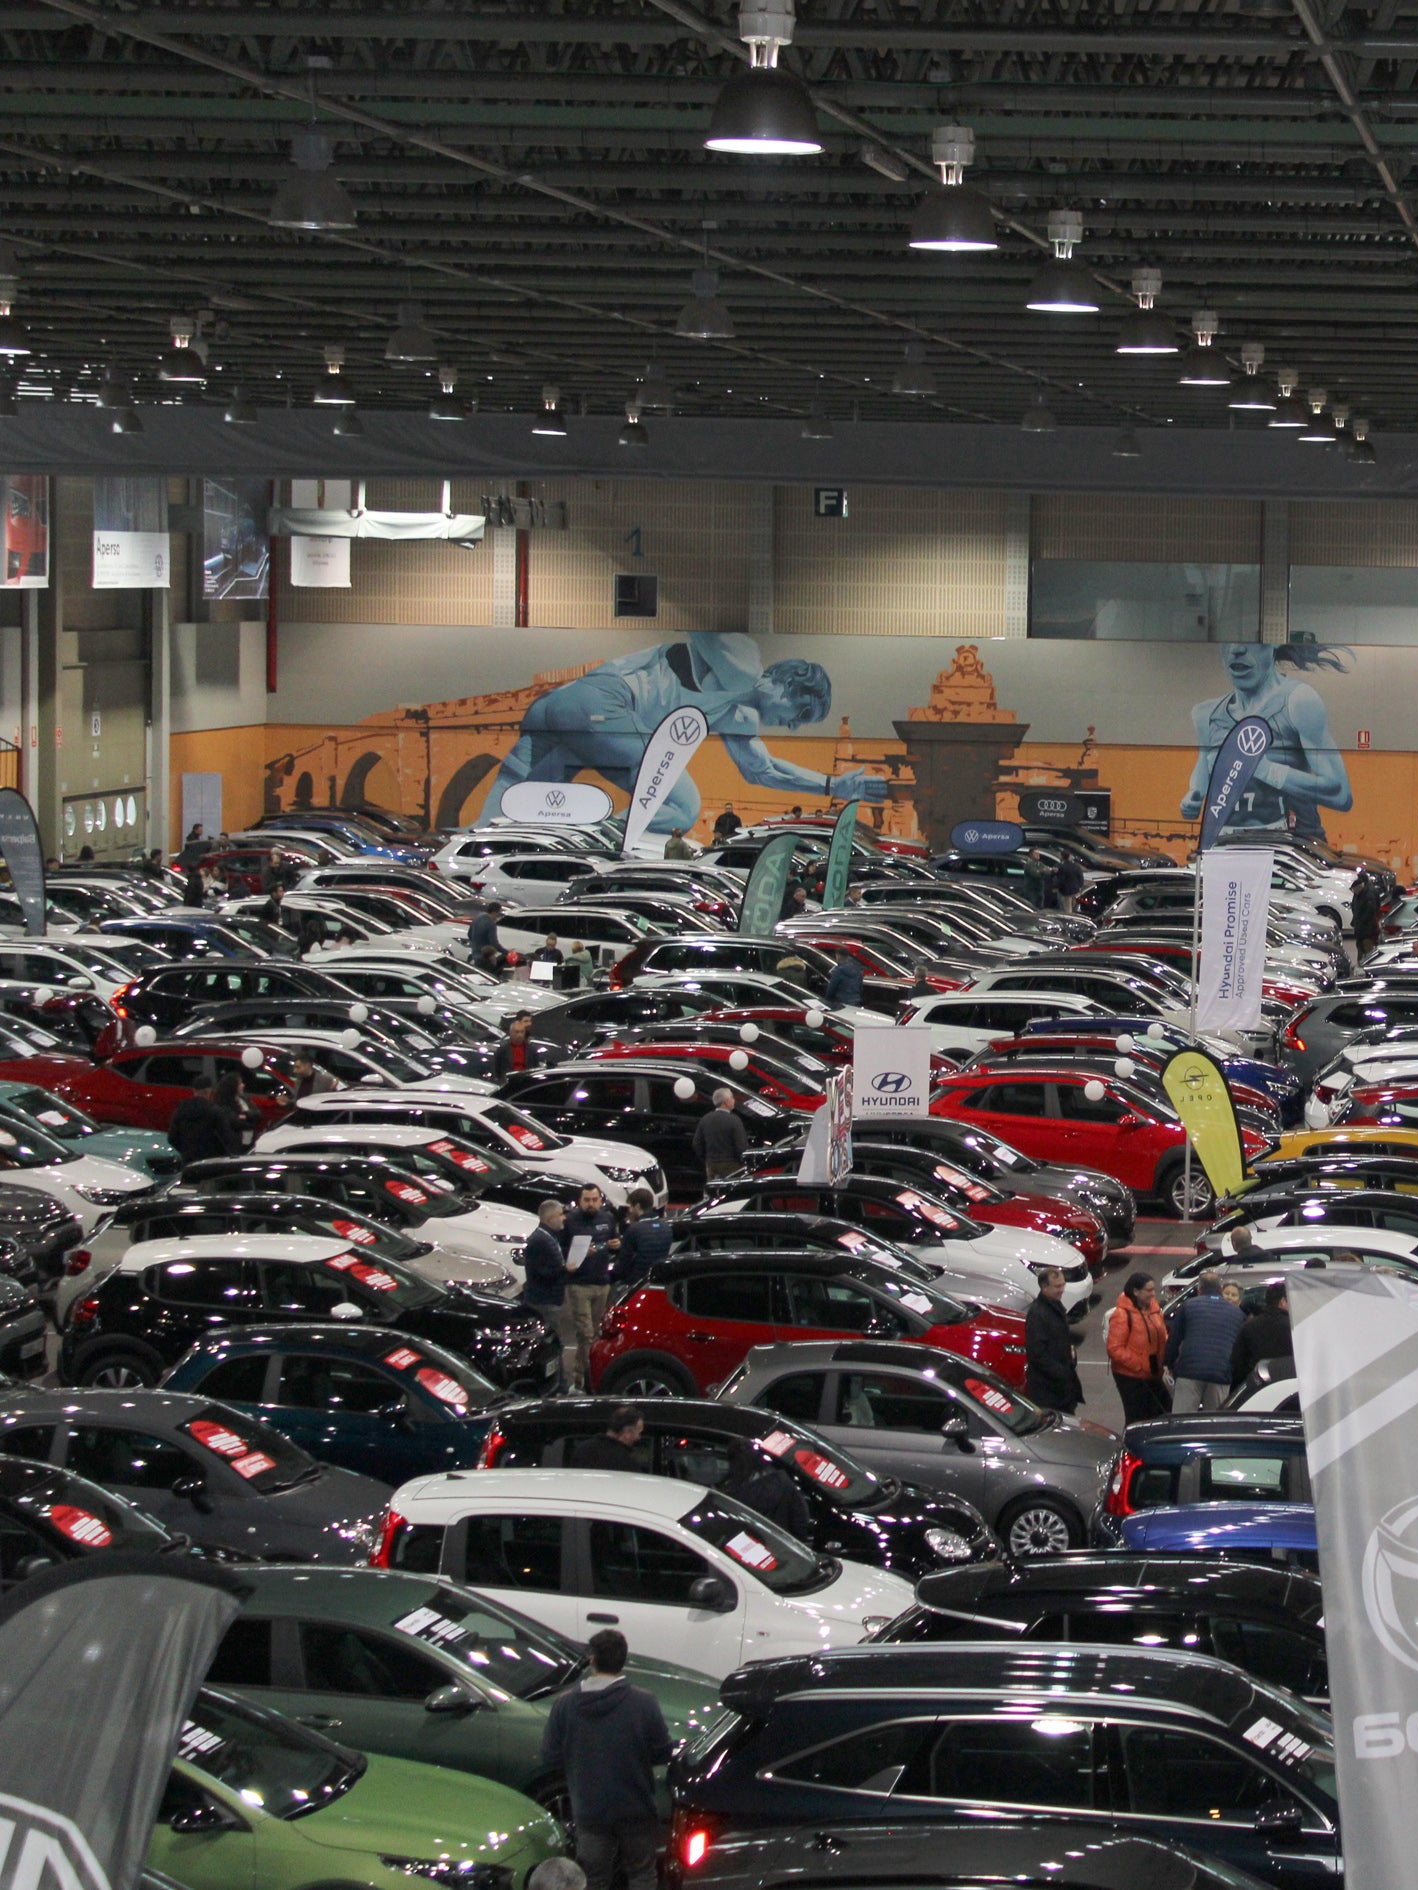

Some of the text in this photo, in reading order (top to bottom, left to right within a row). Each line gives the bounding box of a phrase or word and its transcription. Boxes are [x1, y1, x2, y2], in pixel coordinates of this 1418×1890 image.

[819, 491, 838, 514] F
[639, 751, 675, 809] Apersa
[1210, 760, 1243, 818] Apersa
[537, 809, 572, 818] Apersa
[982, 833, 1010, 841] Apersa
[1218, 881, 1237, 999] Hyundai Promise
[1235, 893, 1252, 999] Approved Used Cars
[862, 1097, 920, 1106] HYUNDAI
